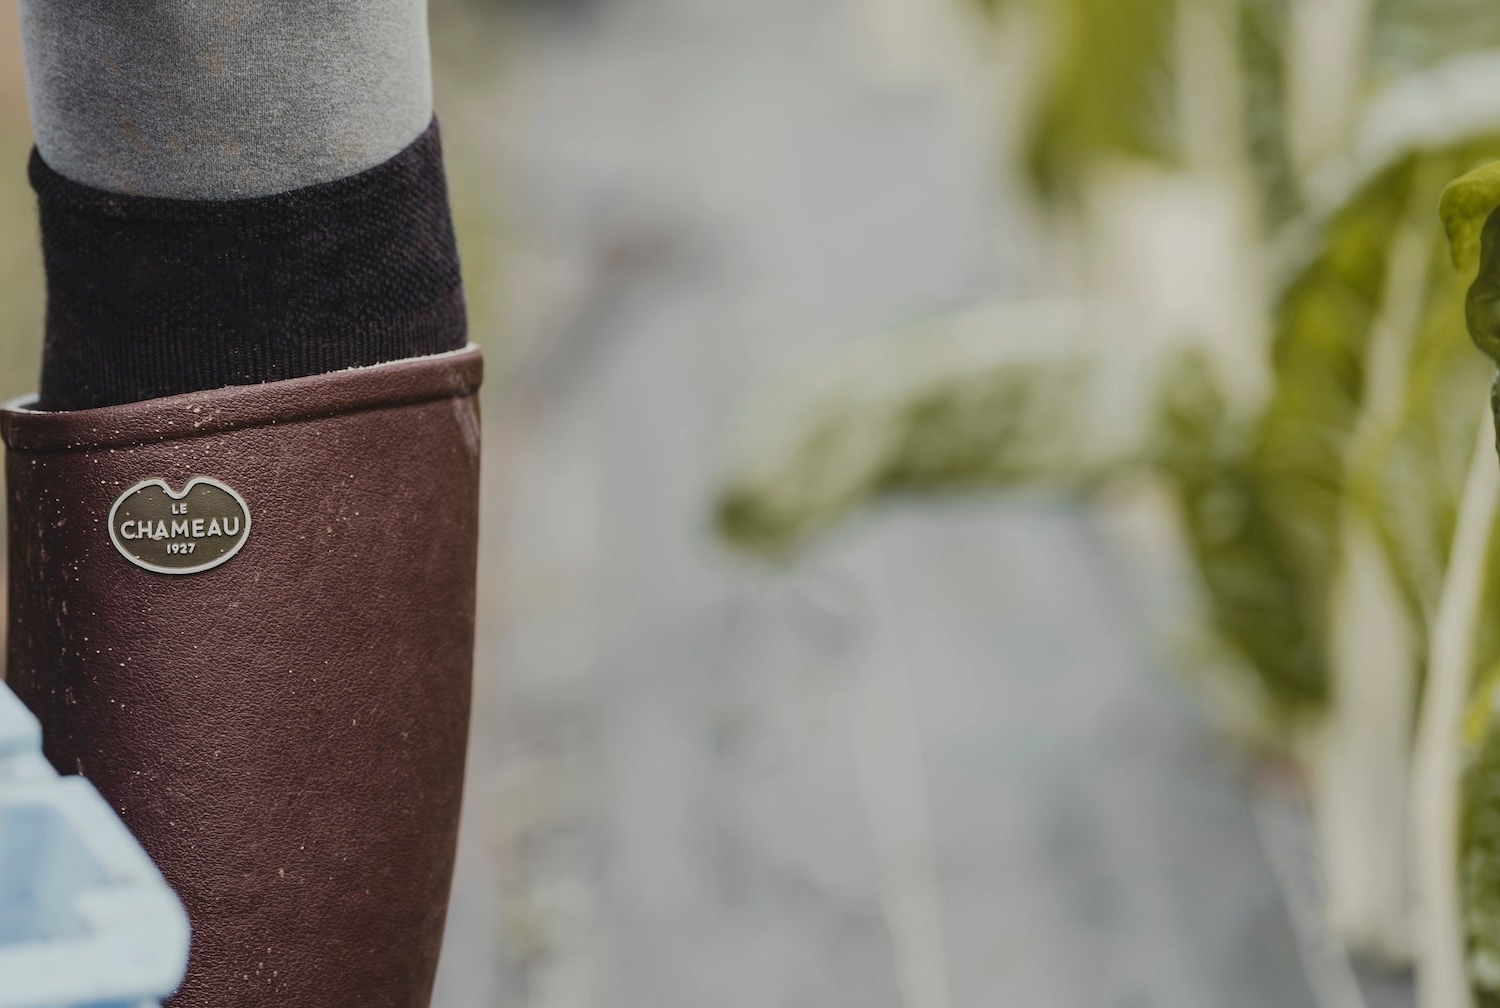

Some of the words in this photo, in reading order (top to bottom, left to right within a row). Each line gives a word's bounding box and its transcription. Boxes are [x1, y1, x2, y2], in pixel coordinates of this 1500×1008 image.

[171, 503, 188, 514] LE
[120, 516, 239, 539] CHAMEAU
[166, 543, 196, 554] 1927
